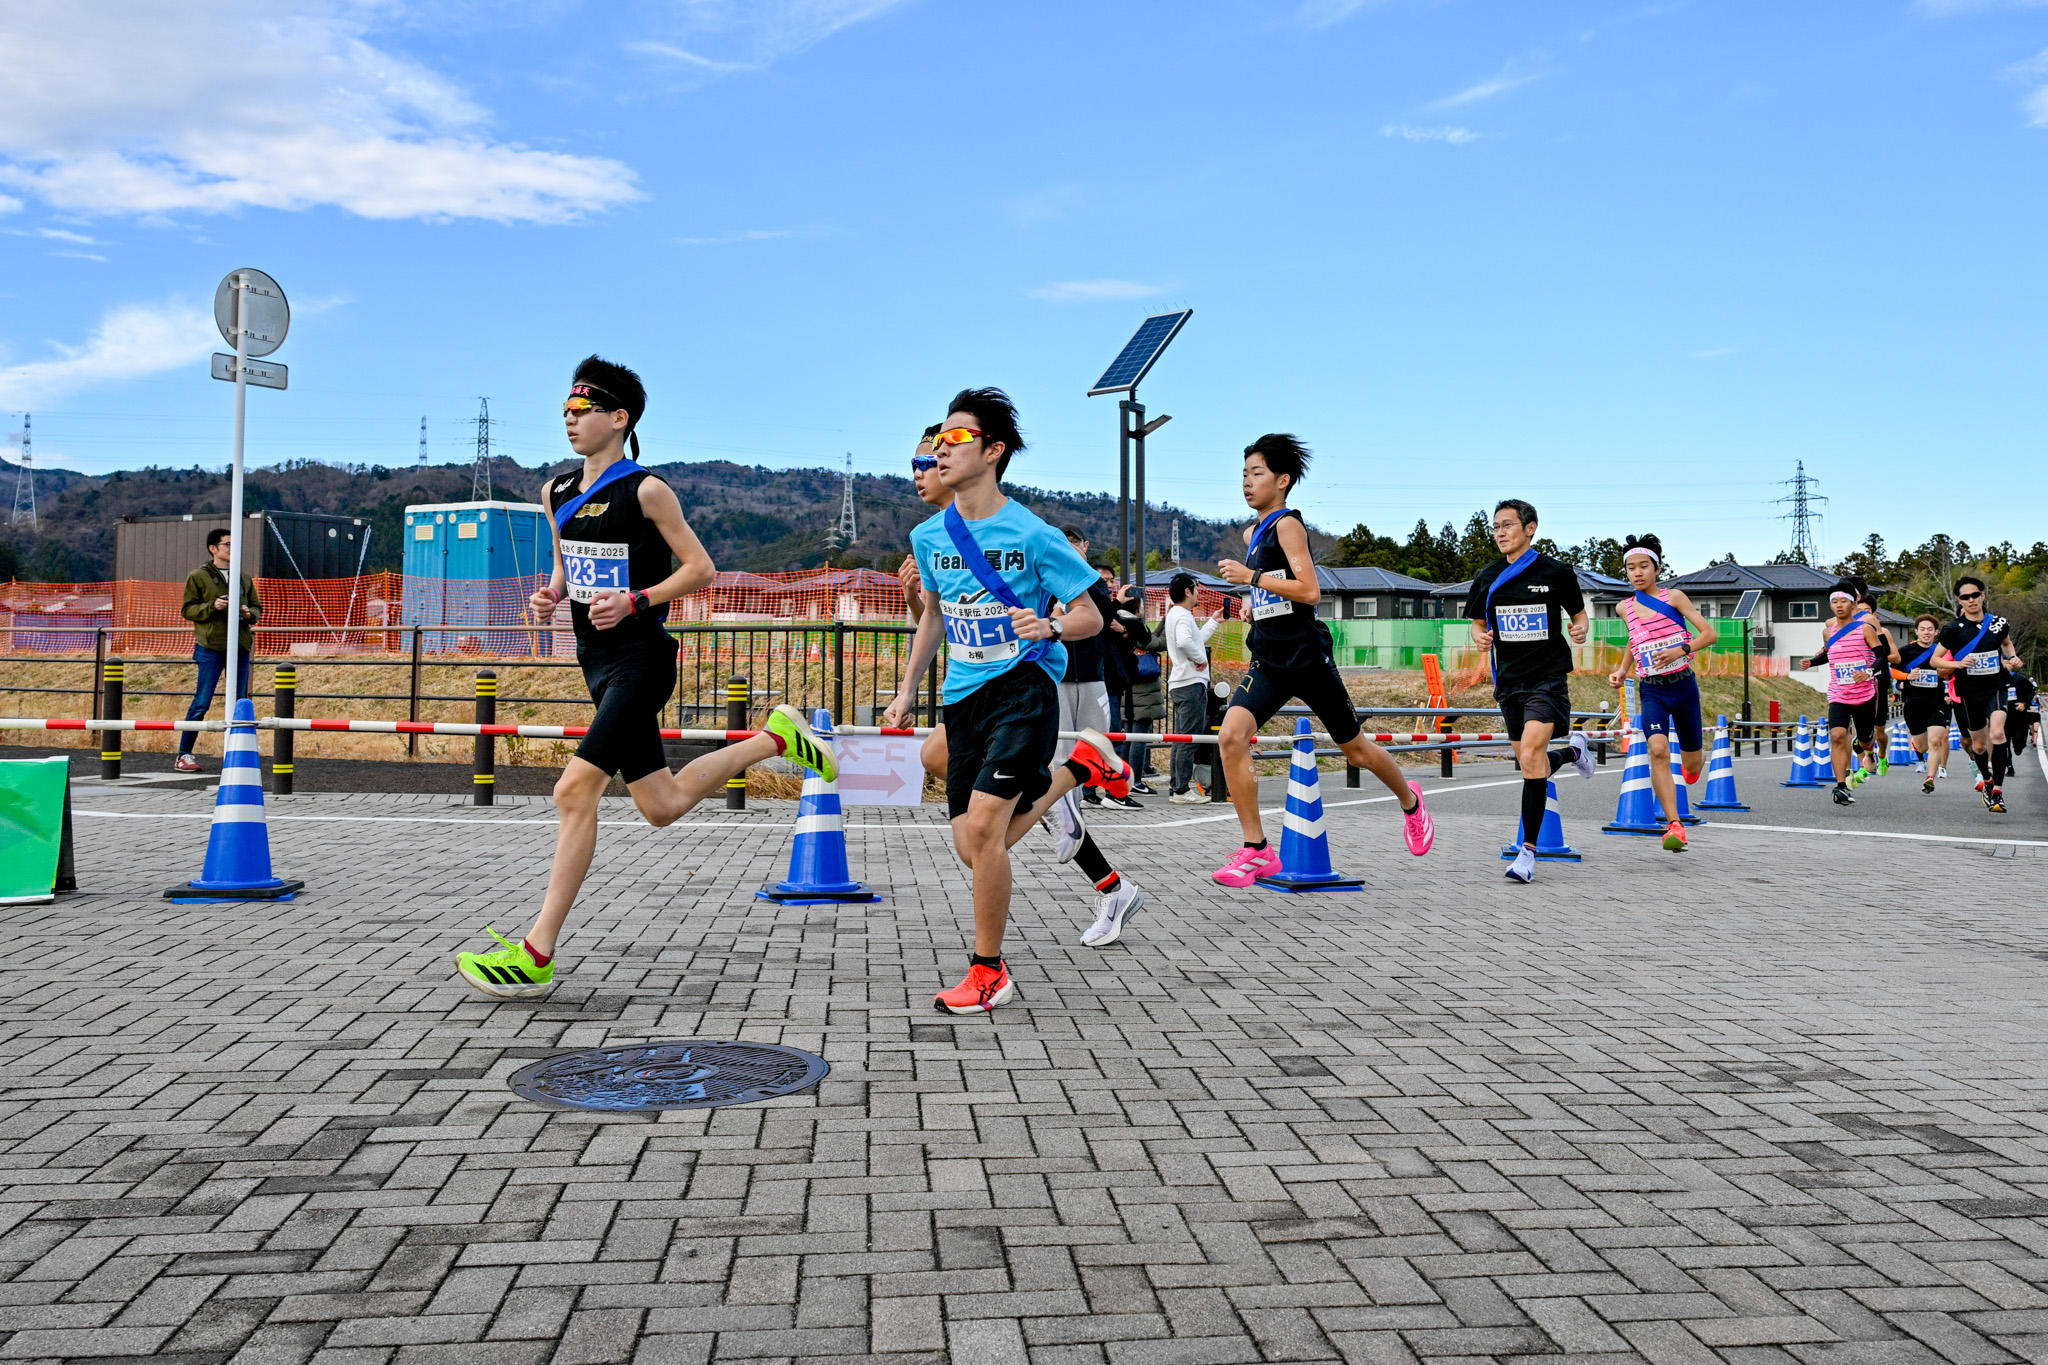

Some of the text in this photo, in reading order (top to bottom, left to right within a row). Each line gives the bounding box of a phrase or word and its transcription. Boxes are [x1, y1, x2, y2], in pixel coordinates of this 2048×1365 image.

[601, 548, 625, 557] 2025
[566, 556, 619, 587] 123-1
[576, 589, 600, 599] 会津A
[985, 604, 1009, 616] 2025
[1501, 615, 1543, 631] 103-1
[1988, 617, 2008, 634] Spo
[949, 618, 1006, 646] 101-1
[1974, 658, 1998, 669] 35-1
